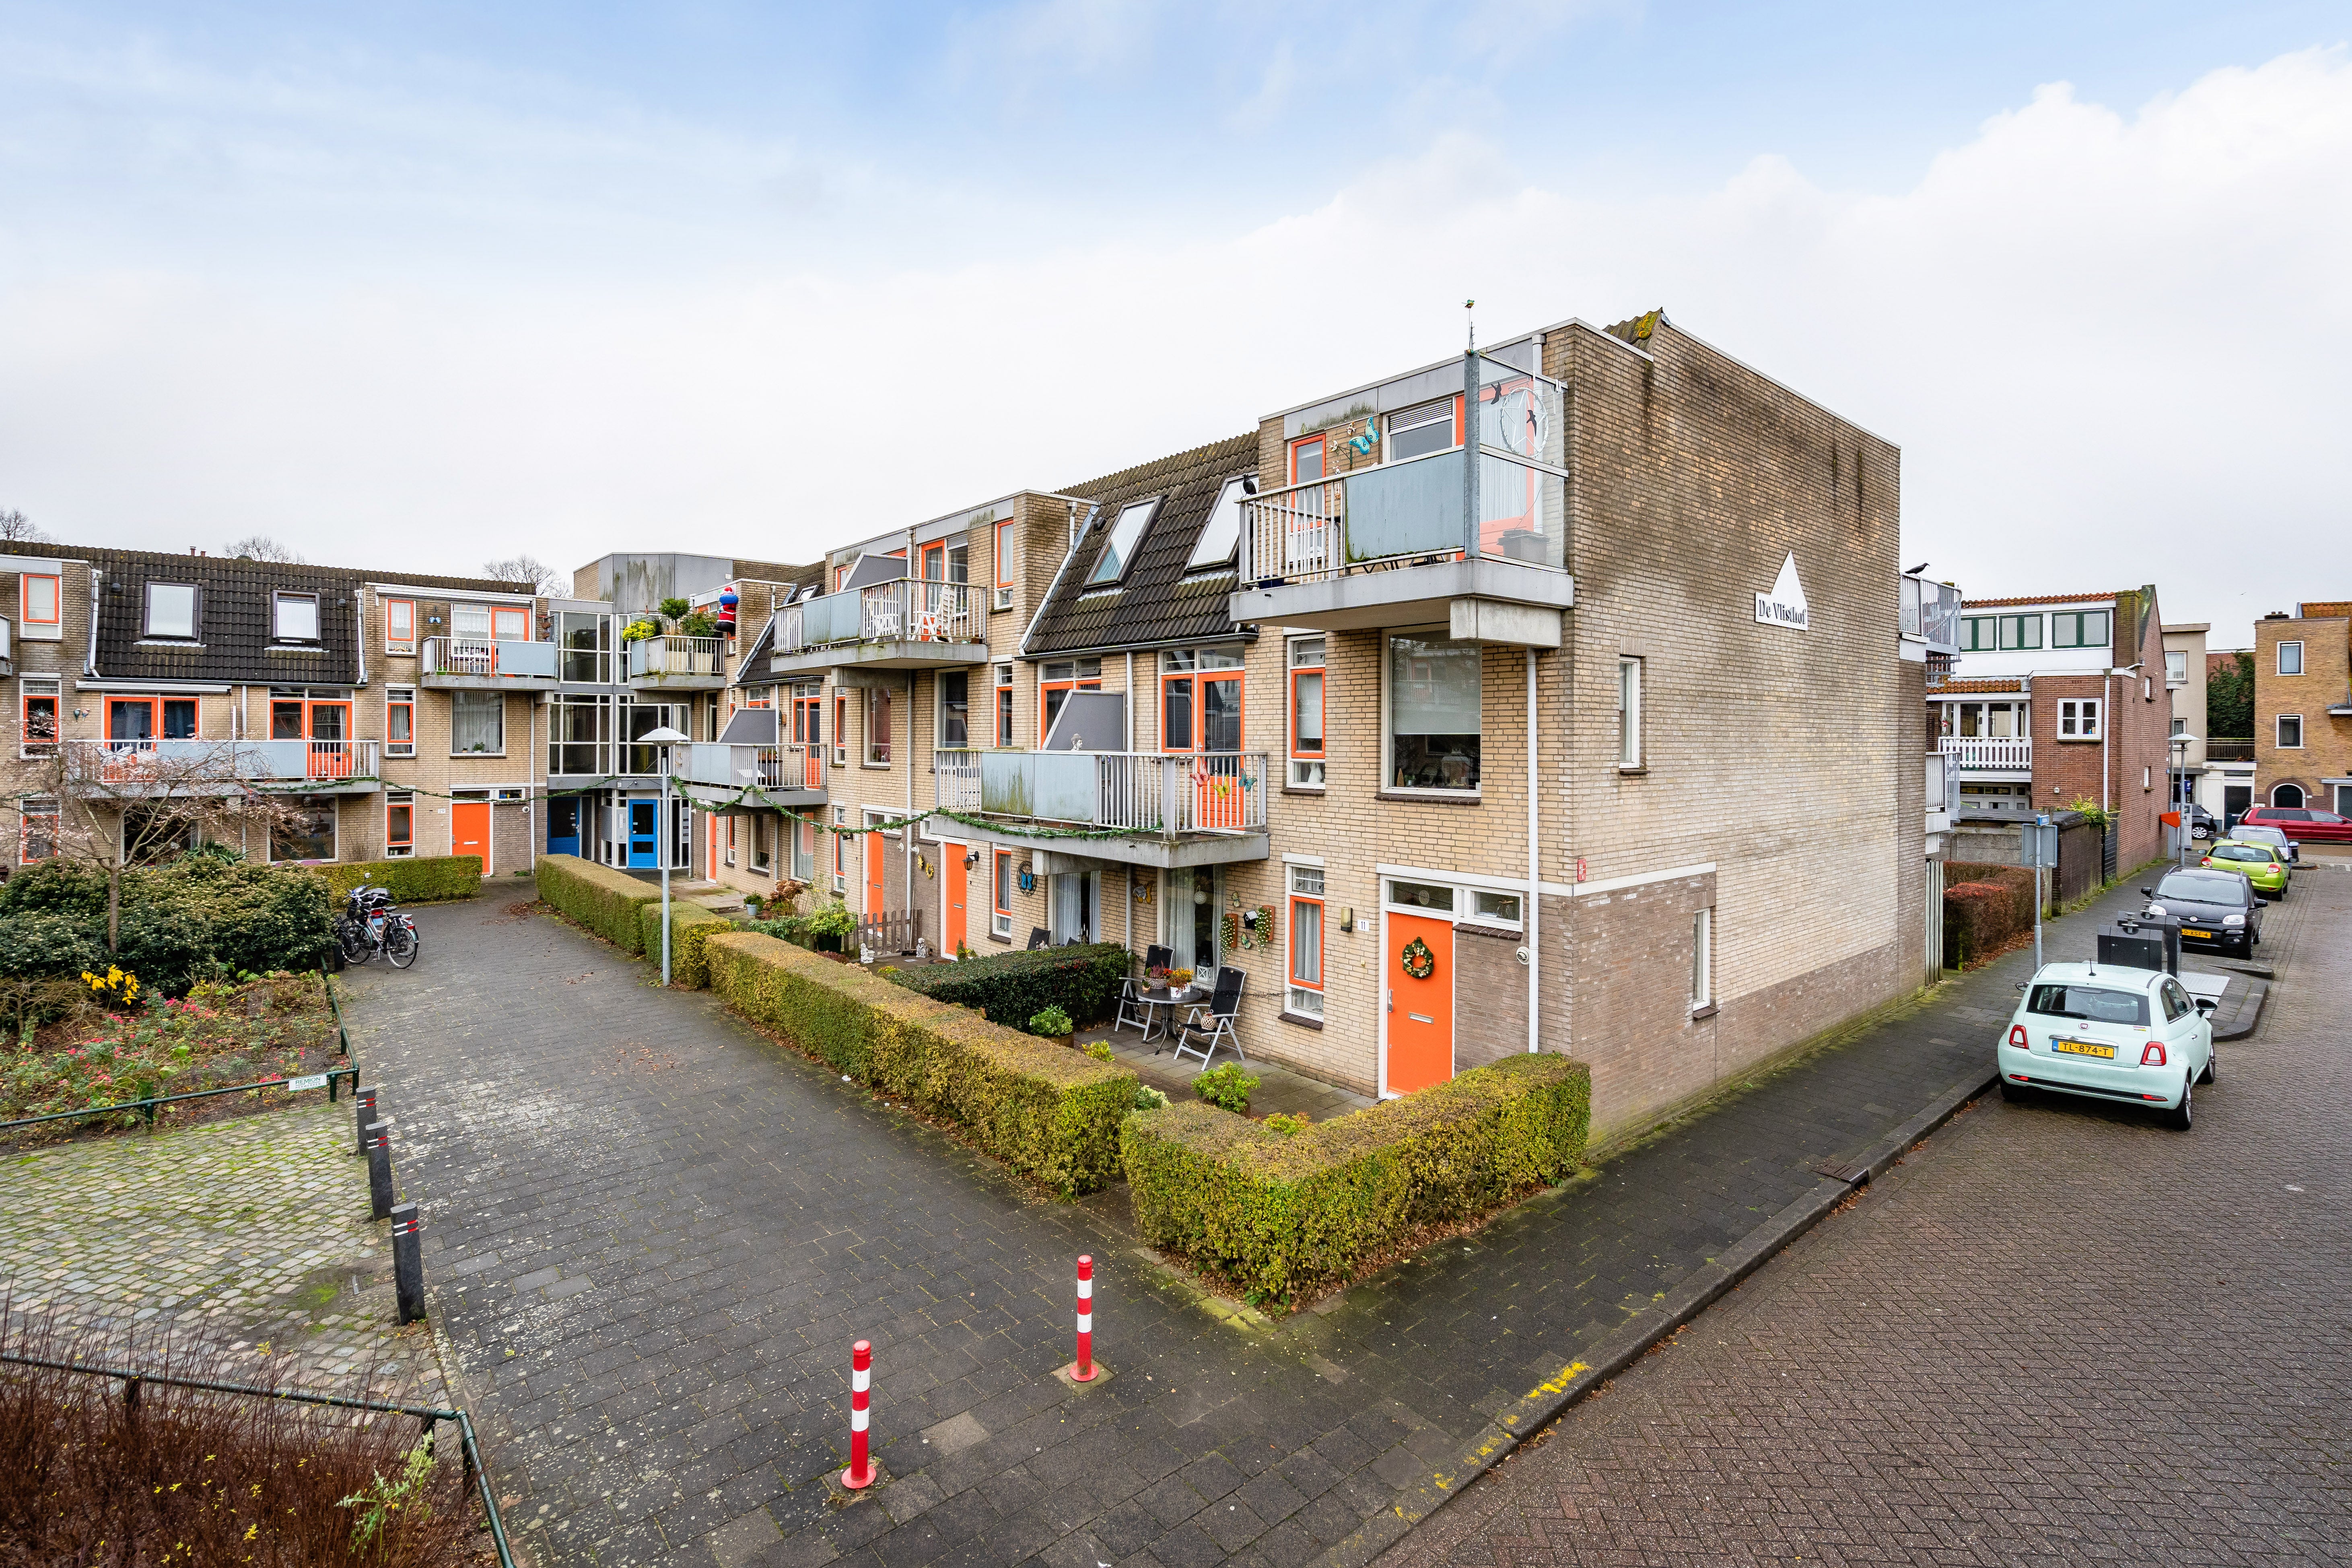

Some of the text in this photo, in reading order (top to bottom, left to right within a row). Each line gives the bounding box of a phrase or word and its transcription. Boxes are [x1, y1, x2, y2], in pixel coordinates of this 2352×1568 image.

[1759, 599, 1806, 624] De Vlisthof
[1361, 921, 1365, 929] 11
[2063, 1043, 2109, 1055] TL-874-T
[295, 1077, 321, 1085] REMION
